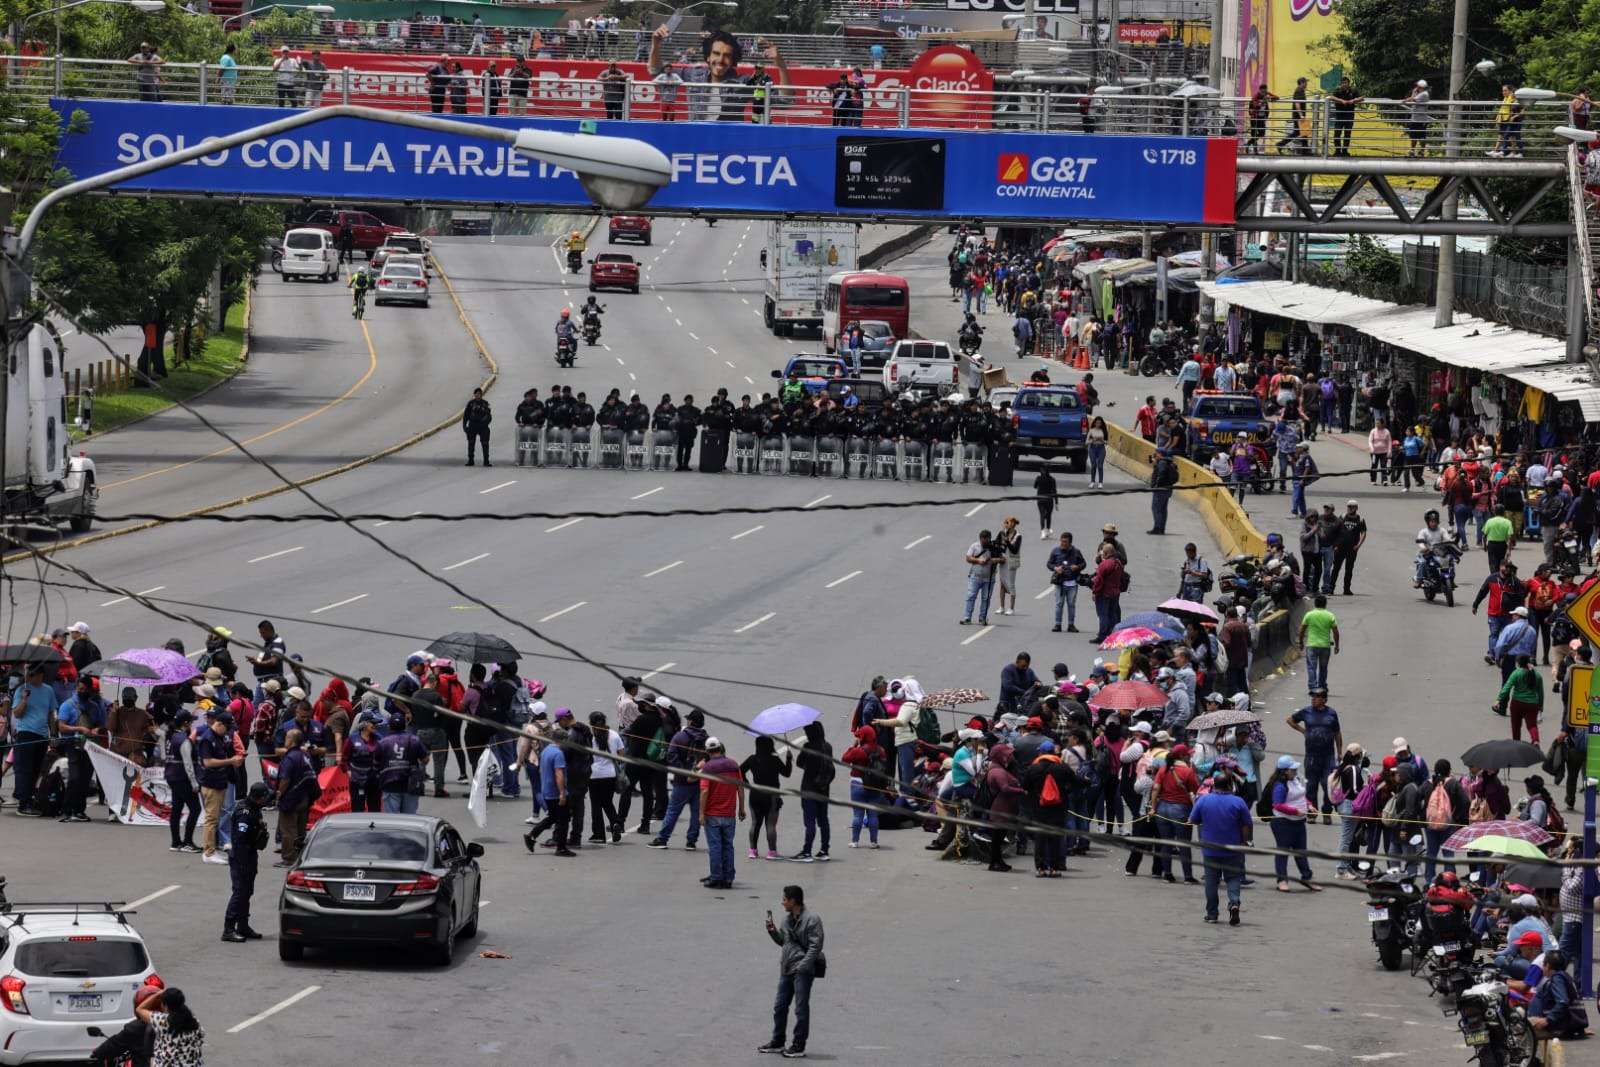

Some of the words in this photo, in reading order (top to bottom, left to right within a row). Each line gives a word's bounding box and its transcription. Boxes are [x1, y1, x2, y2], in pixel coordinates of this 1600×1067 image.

[538, 70, 656, 108] Rápo
[916, 77, 969, 93] Claro
[117, 132, 230, 167] SOLO
[241, 139, 330, 170] CON
[344, 141, 395, 173] LA
[671, 153, 798, 187] FECTA
[1160, 149, 1197, 165] 1718
[1031, 156, 1098, 183] G&T
[996, 185, 1096, 199] CONTINENTAL
